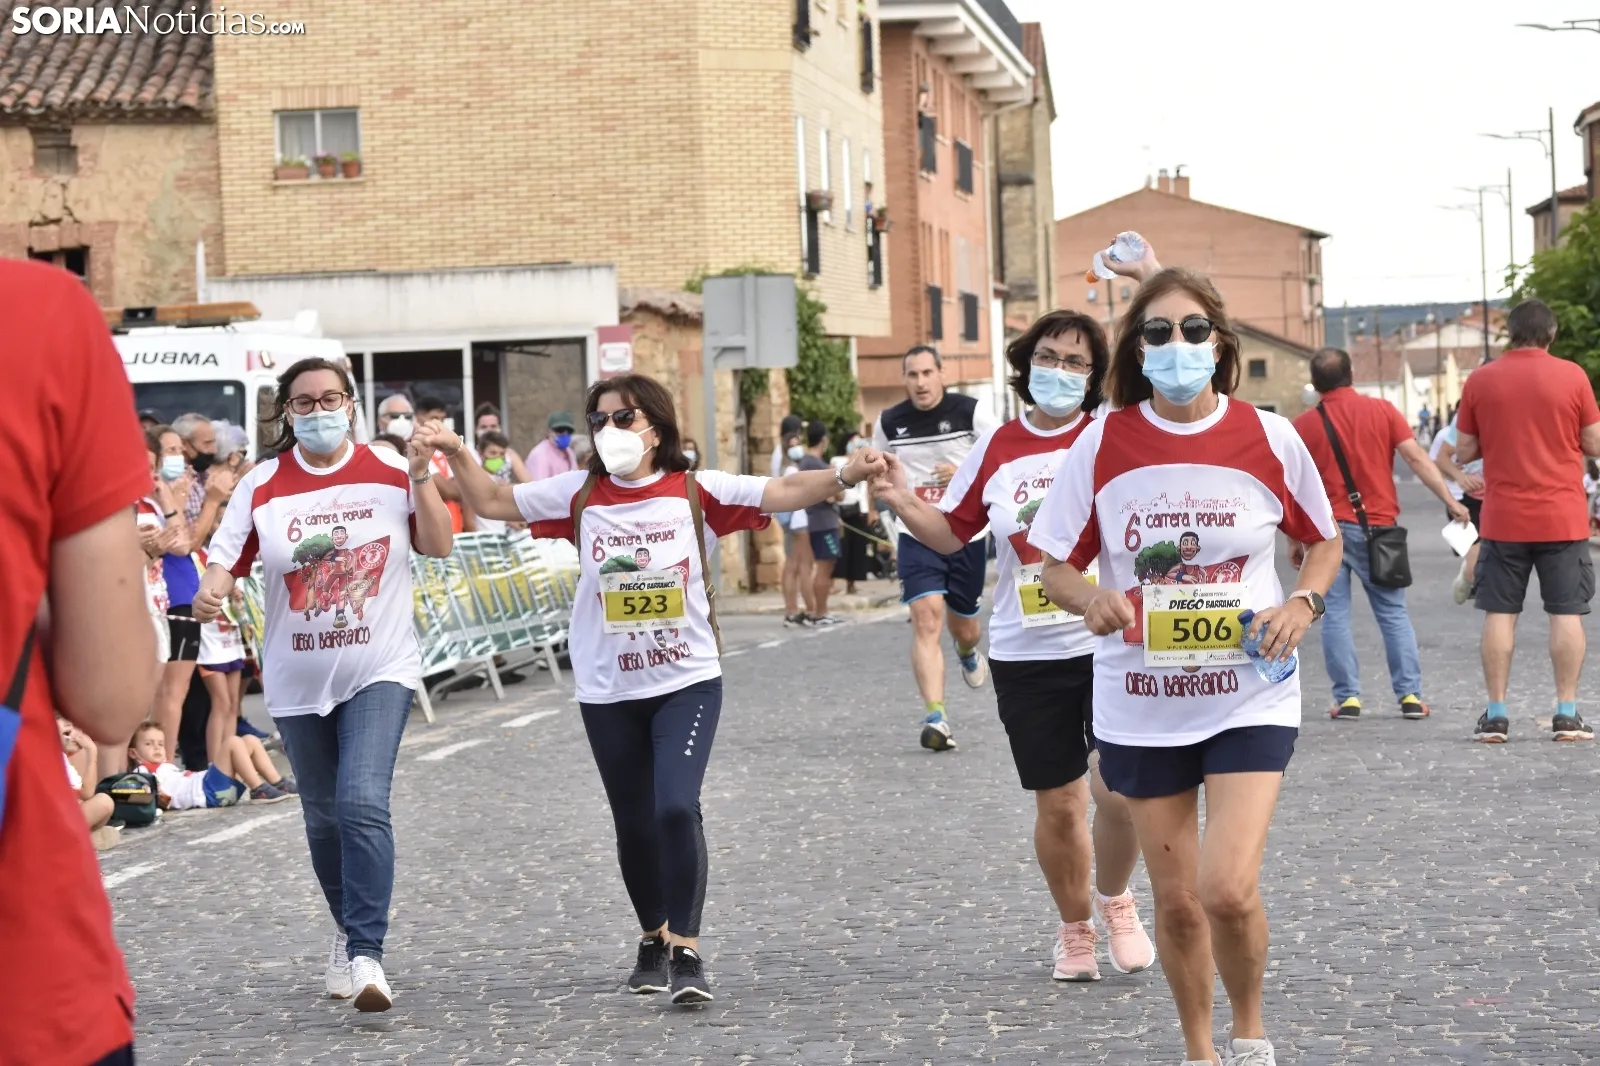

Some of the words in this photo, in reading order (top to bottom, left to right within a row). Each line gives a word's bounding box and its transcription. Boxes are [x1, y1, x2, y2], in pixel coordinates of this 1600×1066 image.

[619, 582, 646, 591] DIEGO
[646, 580, 676, 590] BARRANCO
[623, 594, 668, 615] 523
[1168, 599, 1204, 610] DIEGO
[1205, 598, 1241, 609] BARRANCO
[1172, 616, 1232, 643] 506
[292, 632, 315, 652] DIEGO
[618, 651, 645, 672] DIEGO
[1126, 671, 1159, 697] DIEGO
